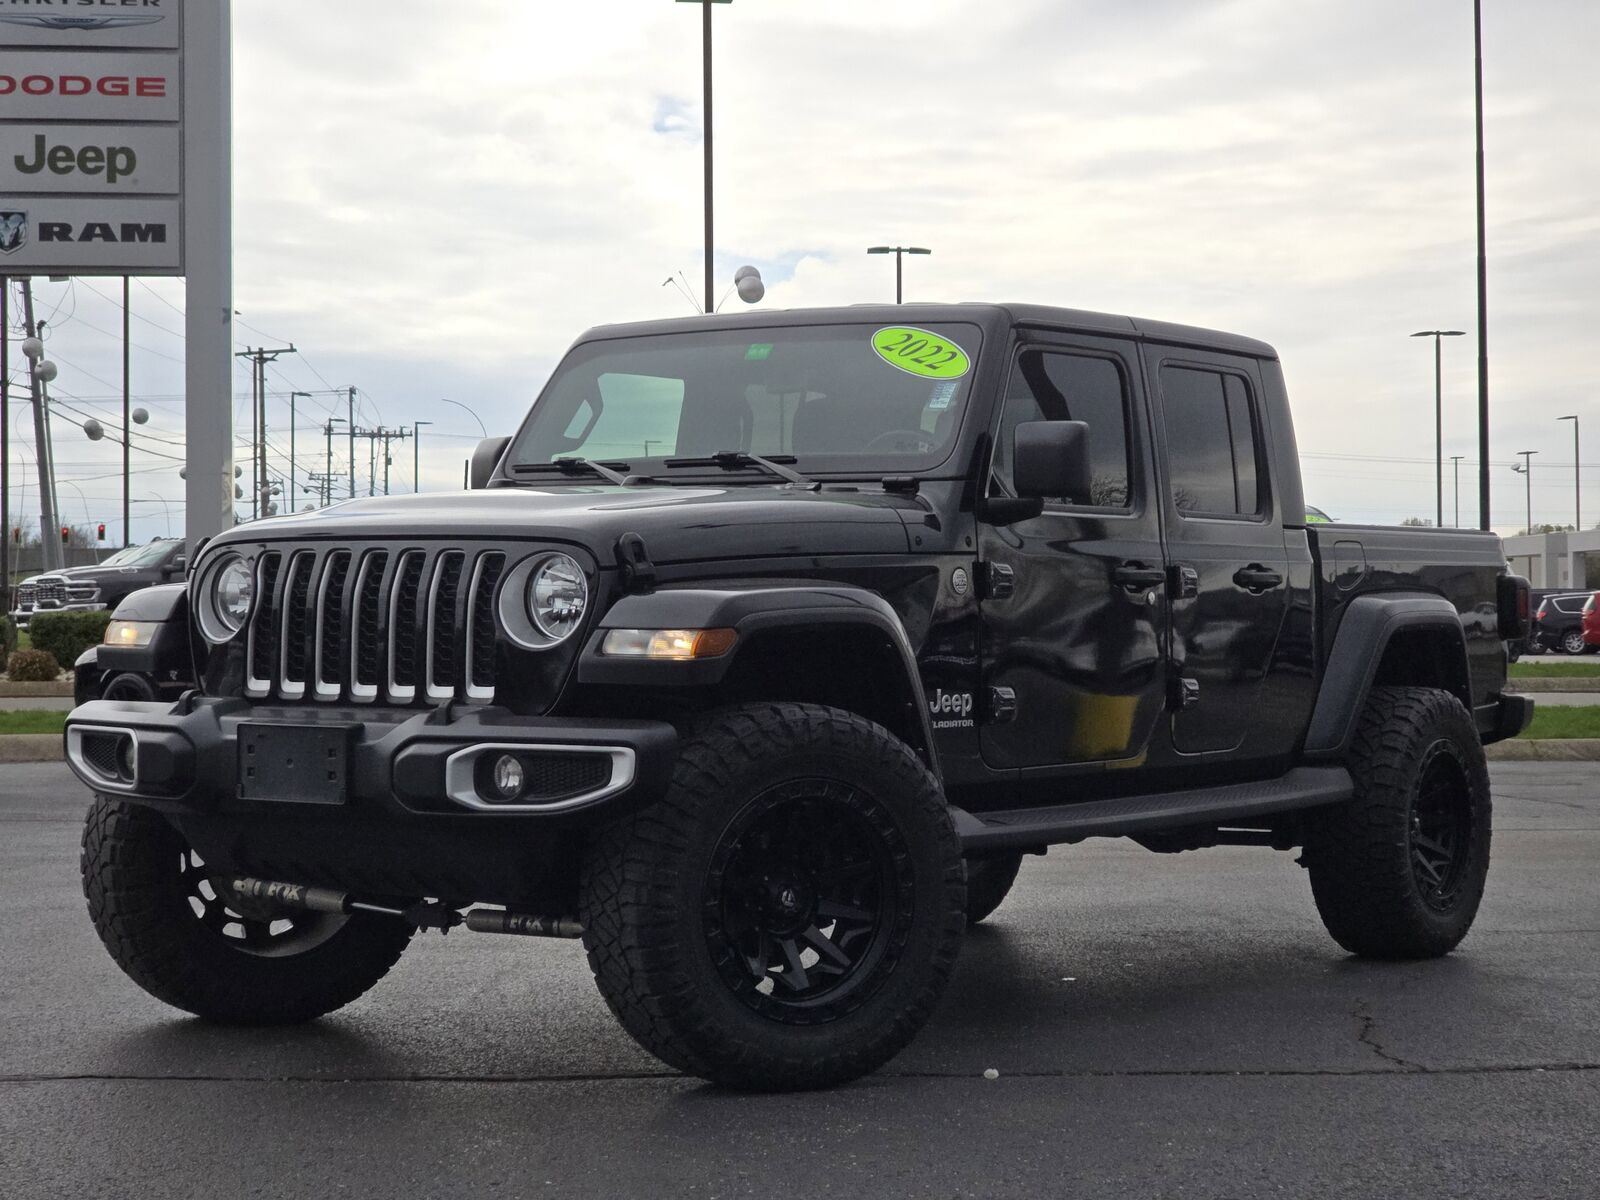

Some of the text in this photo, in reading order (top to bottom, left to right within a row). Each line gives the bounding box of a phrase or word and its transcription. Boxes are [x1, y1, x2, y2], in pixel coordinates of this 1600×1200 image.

[14, 134, 137, 183] Jeep
[38, 222, 166, 243] RAM
[881, 333, 957, 370] 2022
[929, 688, 973, 717] Jeep
[931, 719, 974, 729] LADIATOR
